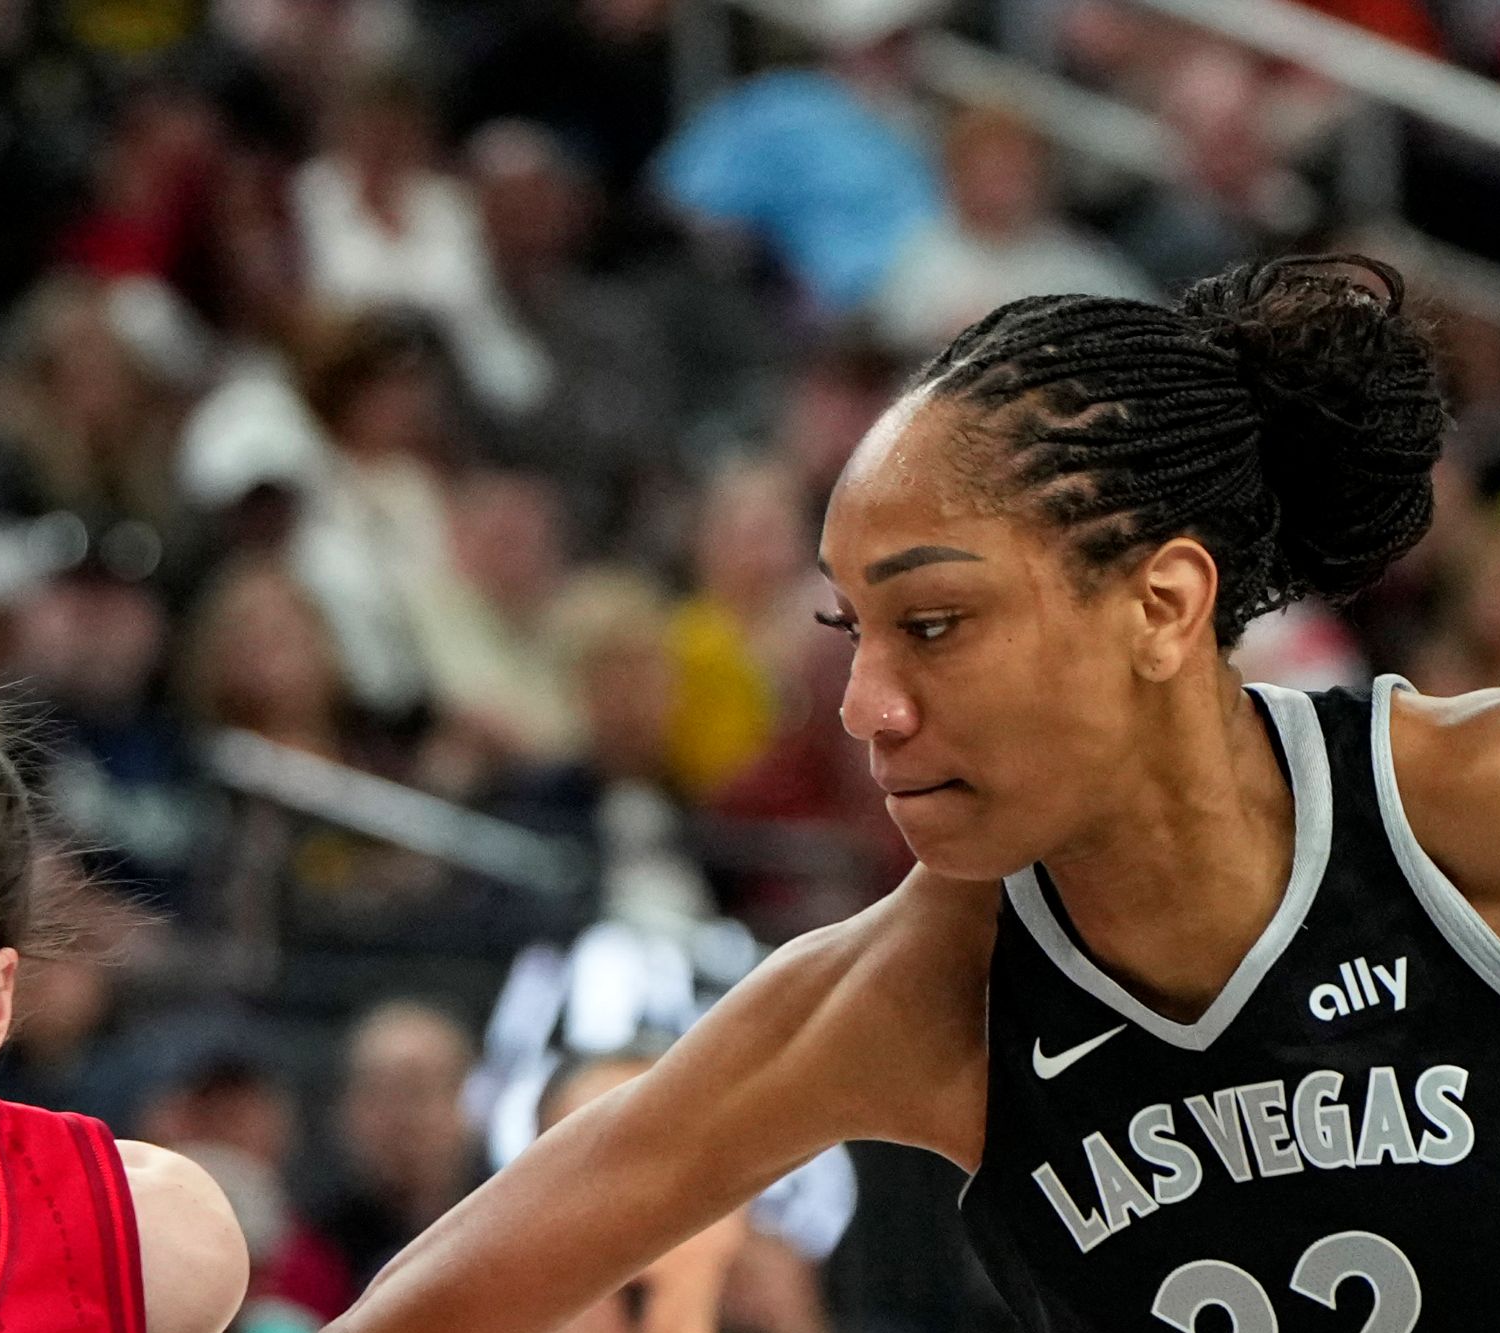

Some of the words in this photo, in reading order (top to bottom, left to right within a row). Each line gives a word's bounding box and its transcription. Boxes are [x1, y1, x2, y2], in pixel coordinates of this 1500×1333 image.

[1307, 956, 1408, 1021] ally
[1031, 1103, 1203, 1254] LAS
[1183, 1064, 1475, 1184] VEGAS
